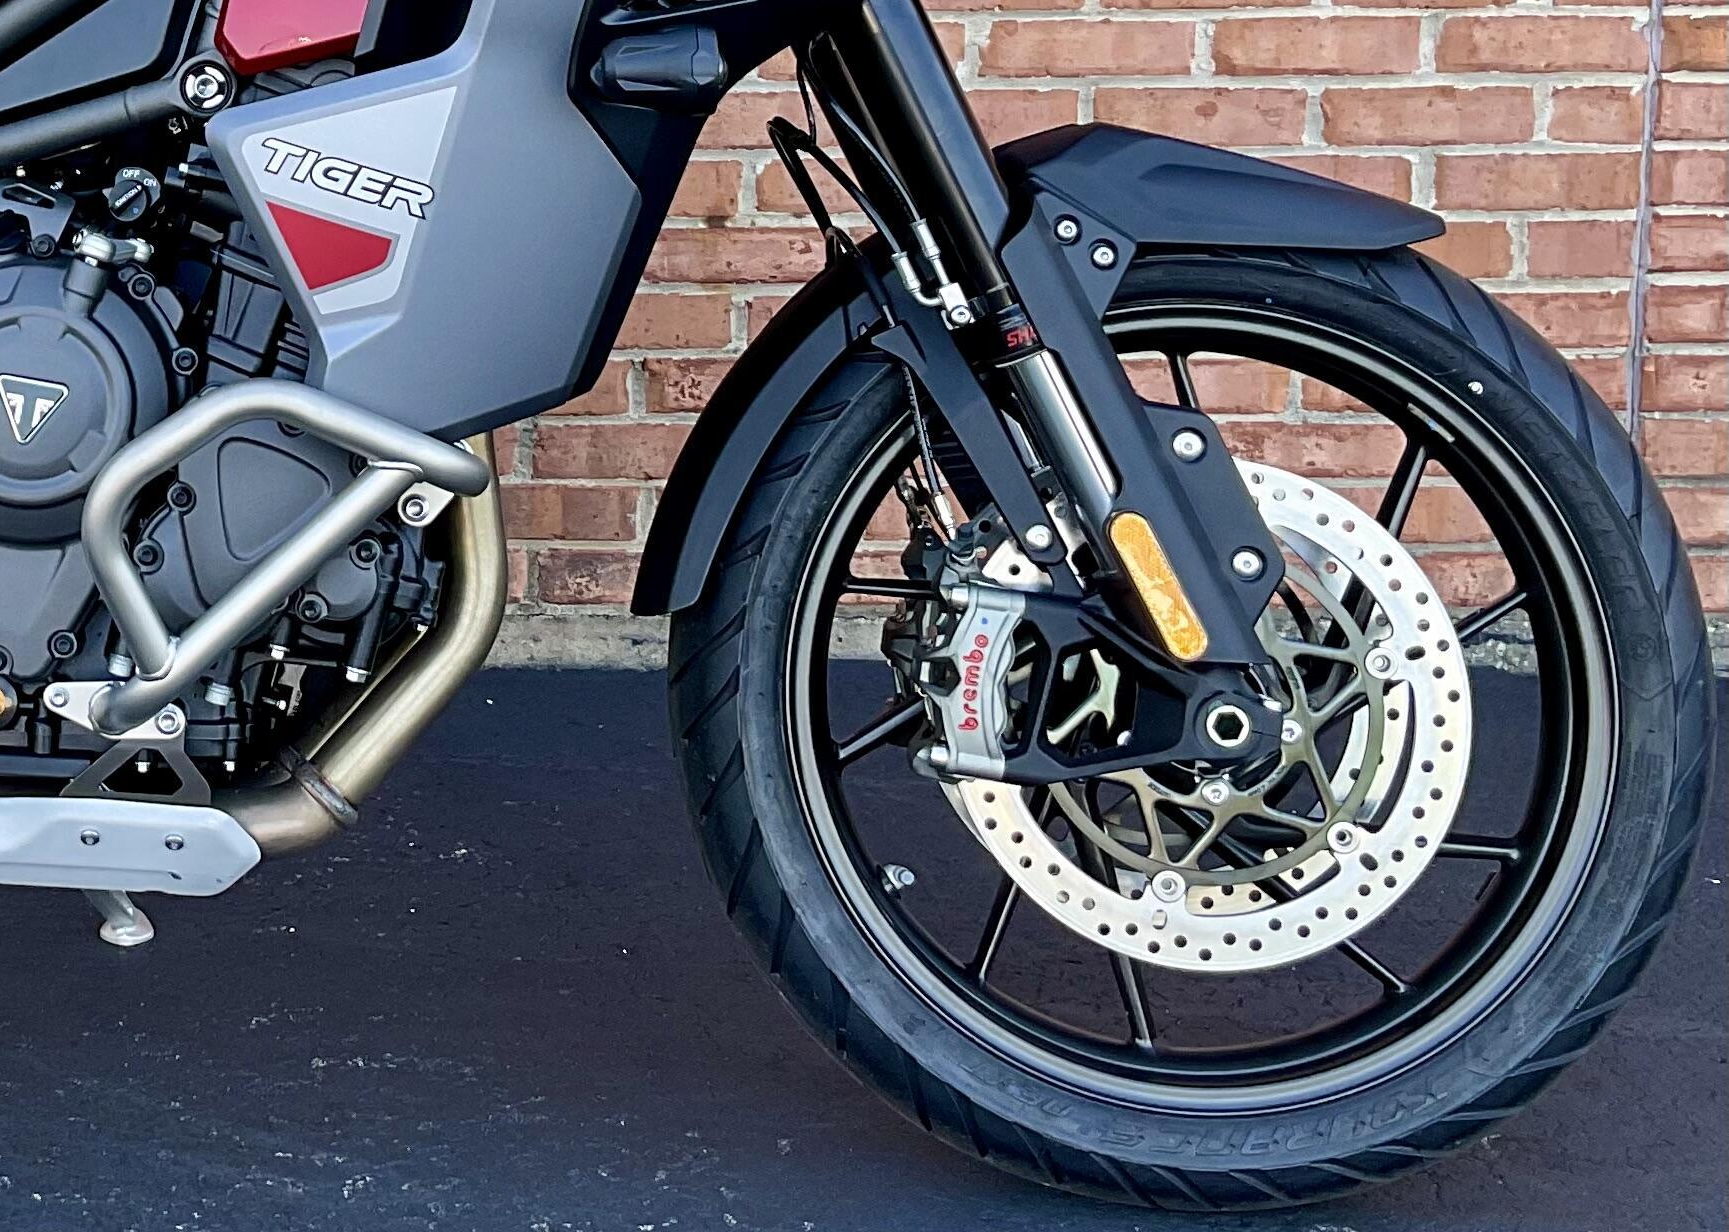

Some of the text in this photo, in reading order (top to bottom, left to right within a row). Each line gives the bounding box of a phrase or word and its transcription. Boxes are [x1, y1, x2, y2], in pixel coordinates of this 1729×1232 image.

[122, 168, 141, 178] OFF
[143, 178, 157, 187] ON
[261, 136, 436, 221] TIGER
[958, 633, 990, 732] brembo
